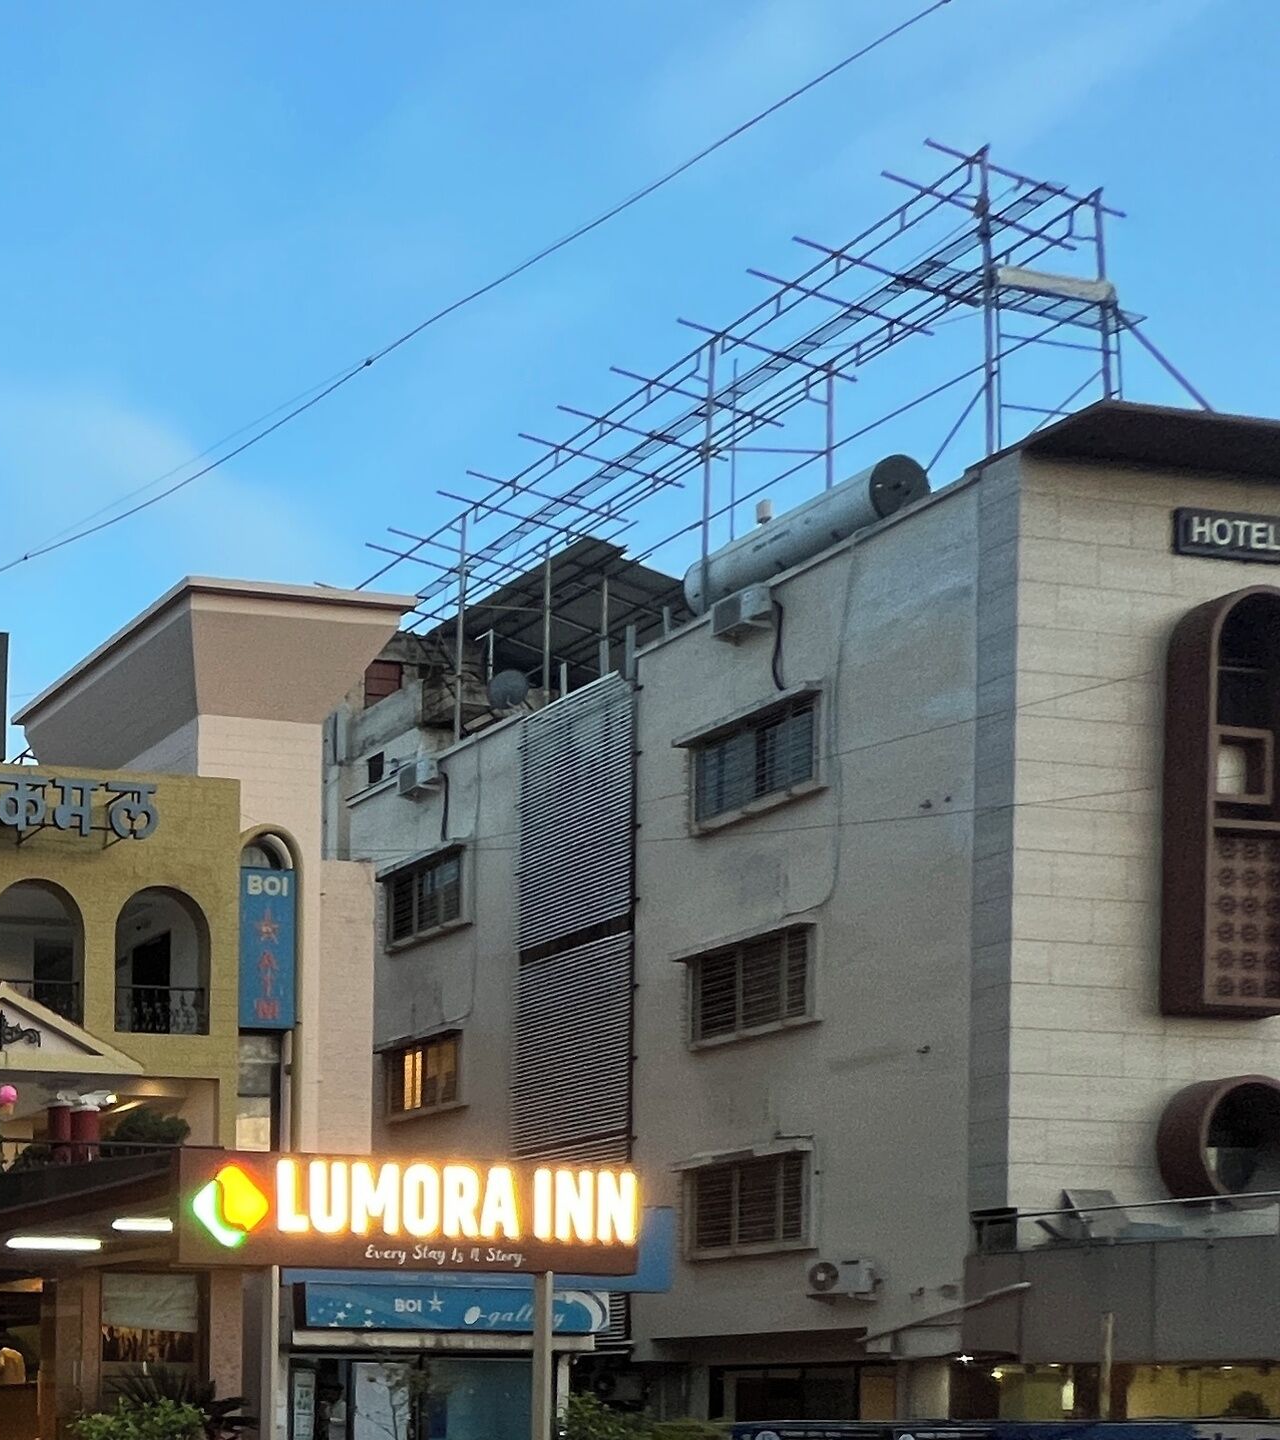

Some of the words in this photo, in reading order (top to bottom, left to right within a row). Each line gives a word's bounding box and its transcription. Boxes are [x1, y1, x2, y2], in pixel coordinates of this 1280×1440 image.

[1191, 516, 1279, 550] HOTEL
[247, 874, 289, 897] BOI
[275, 1158, 521, 1241] LUMORA
[532, 1166, 639, 1247] INN
[365, 1244, 406, 1265] Every
[412, 1244, 446, 1265] Stay
[394, 1298, 422, 1313] BOI
